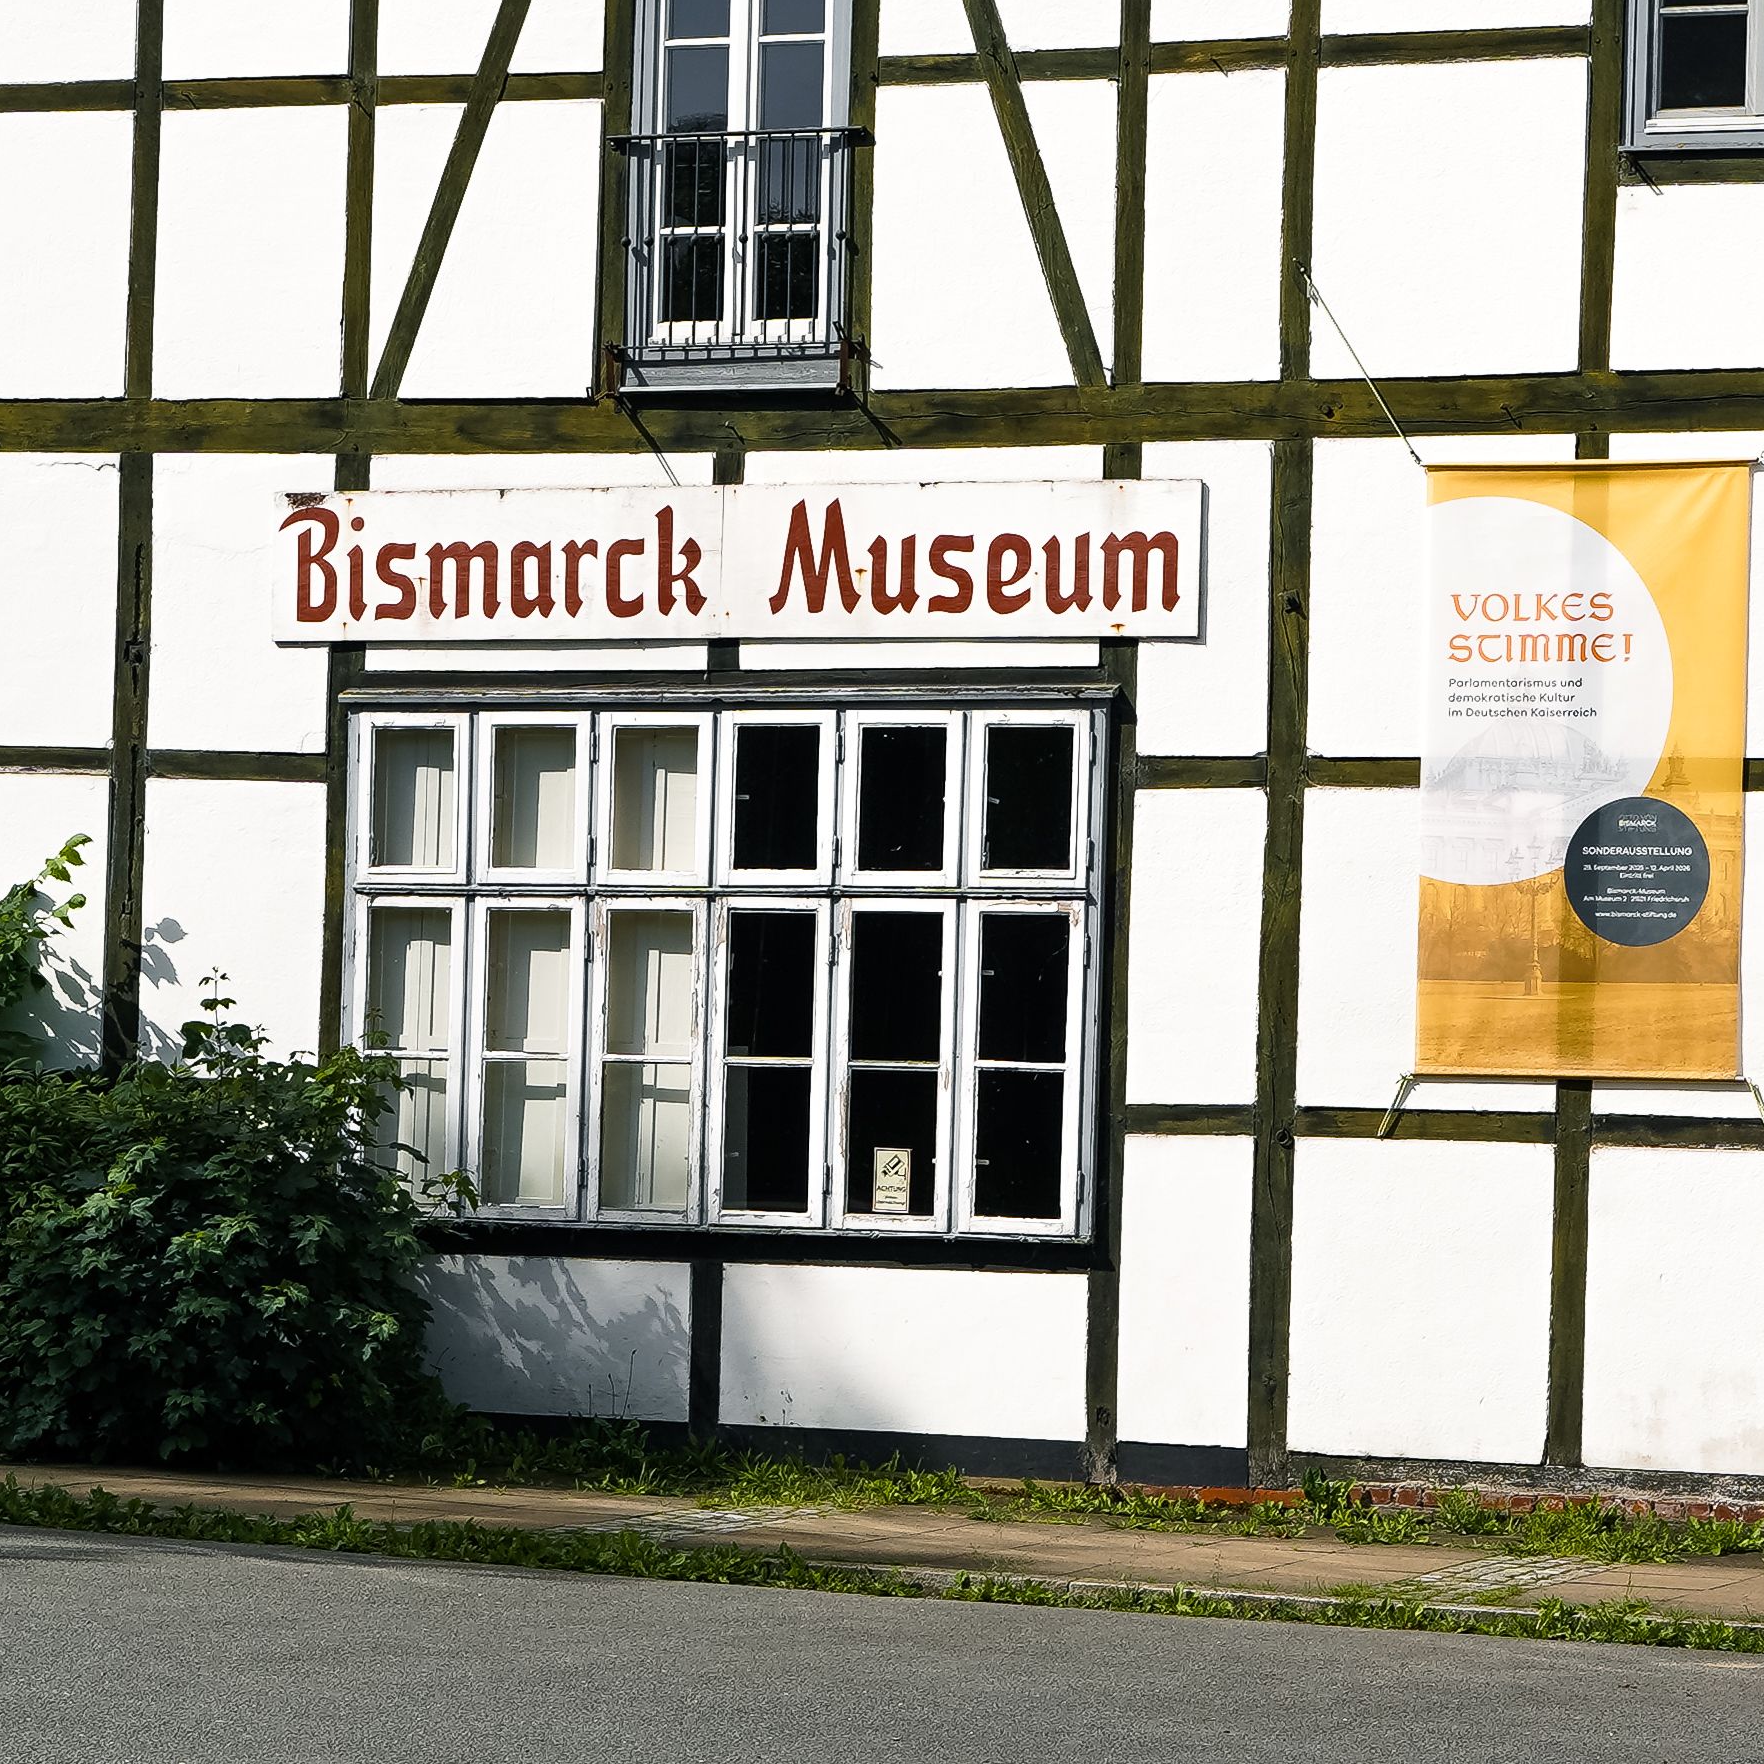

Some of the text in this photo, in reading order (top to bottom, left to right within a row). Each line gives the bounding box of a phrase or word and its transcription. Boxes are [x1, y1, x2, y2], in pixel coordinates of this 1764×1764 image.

[278, 498, 1181, 623] Bismarck Museum
[1450, 593, 1614, 622] VOLKES
[1447, 634, 1634, 663] STIMME!
[1448, 677, 1583, 687] Parlamentarismus und
[1448, 693, 1576, 702] demokratische Kultur
[1448, 708, 1597, 717] im Deutschen Kaiserreich
[1582, 846, 1693, 856] SONDERAUSSTELLUNG
